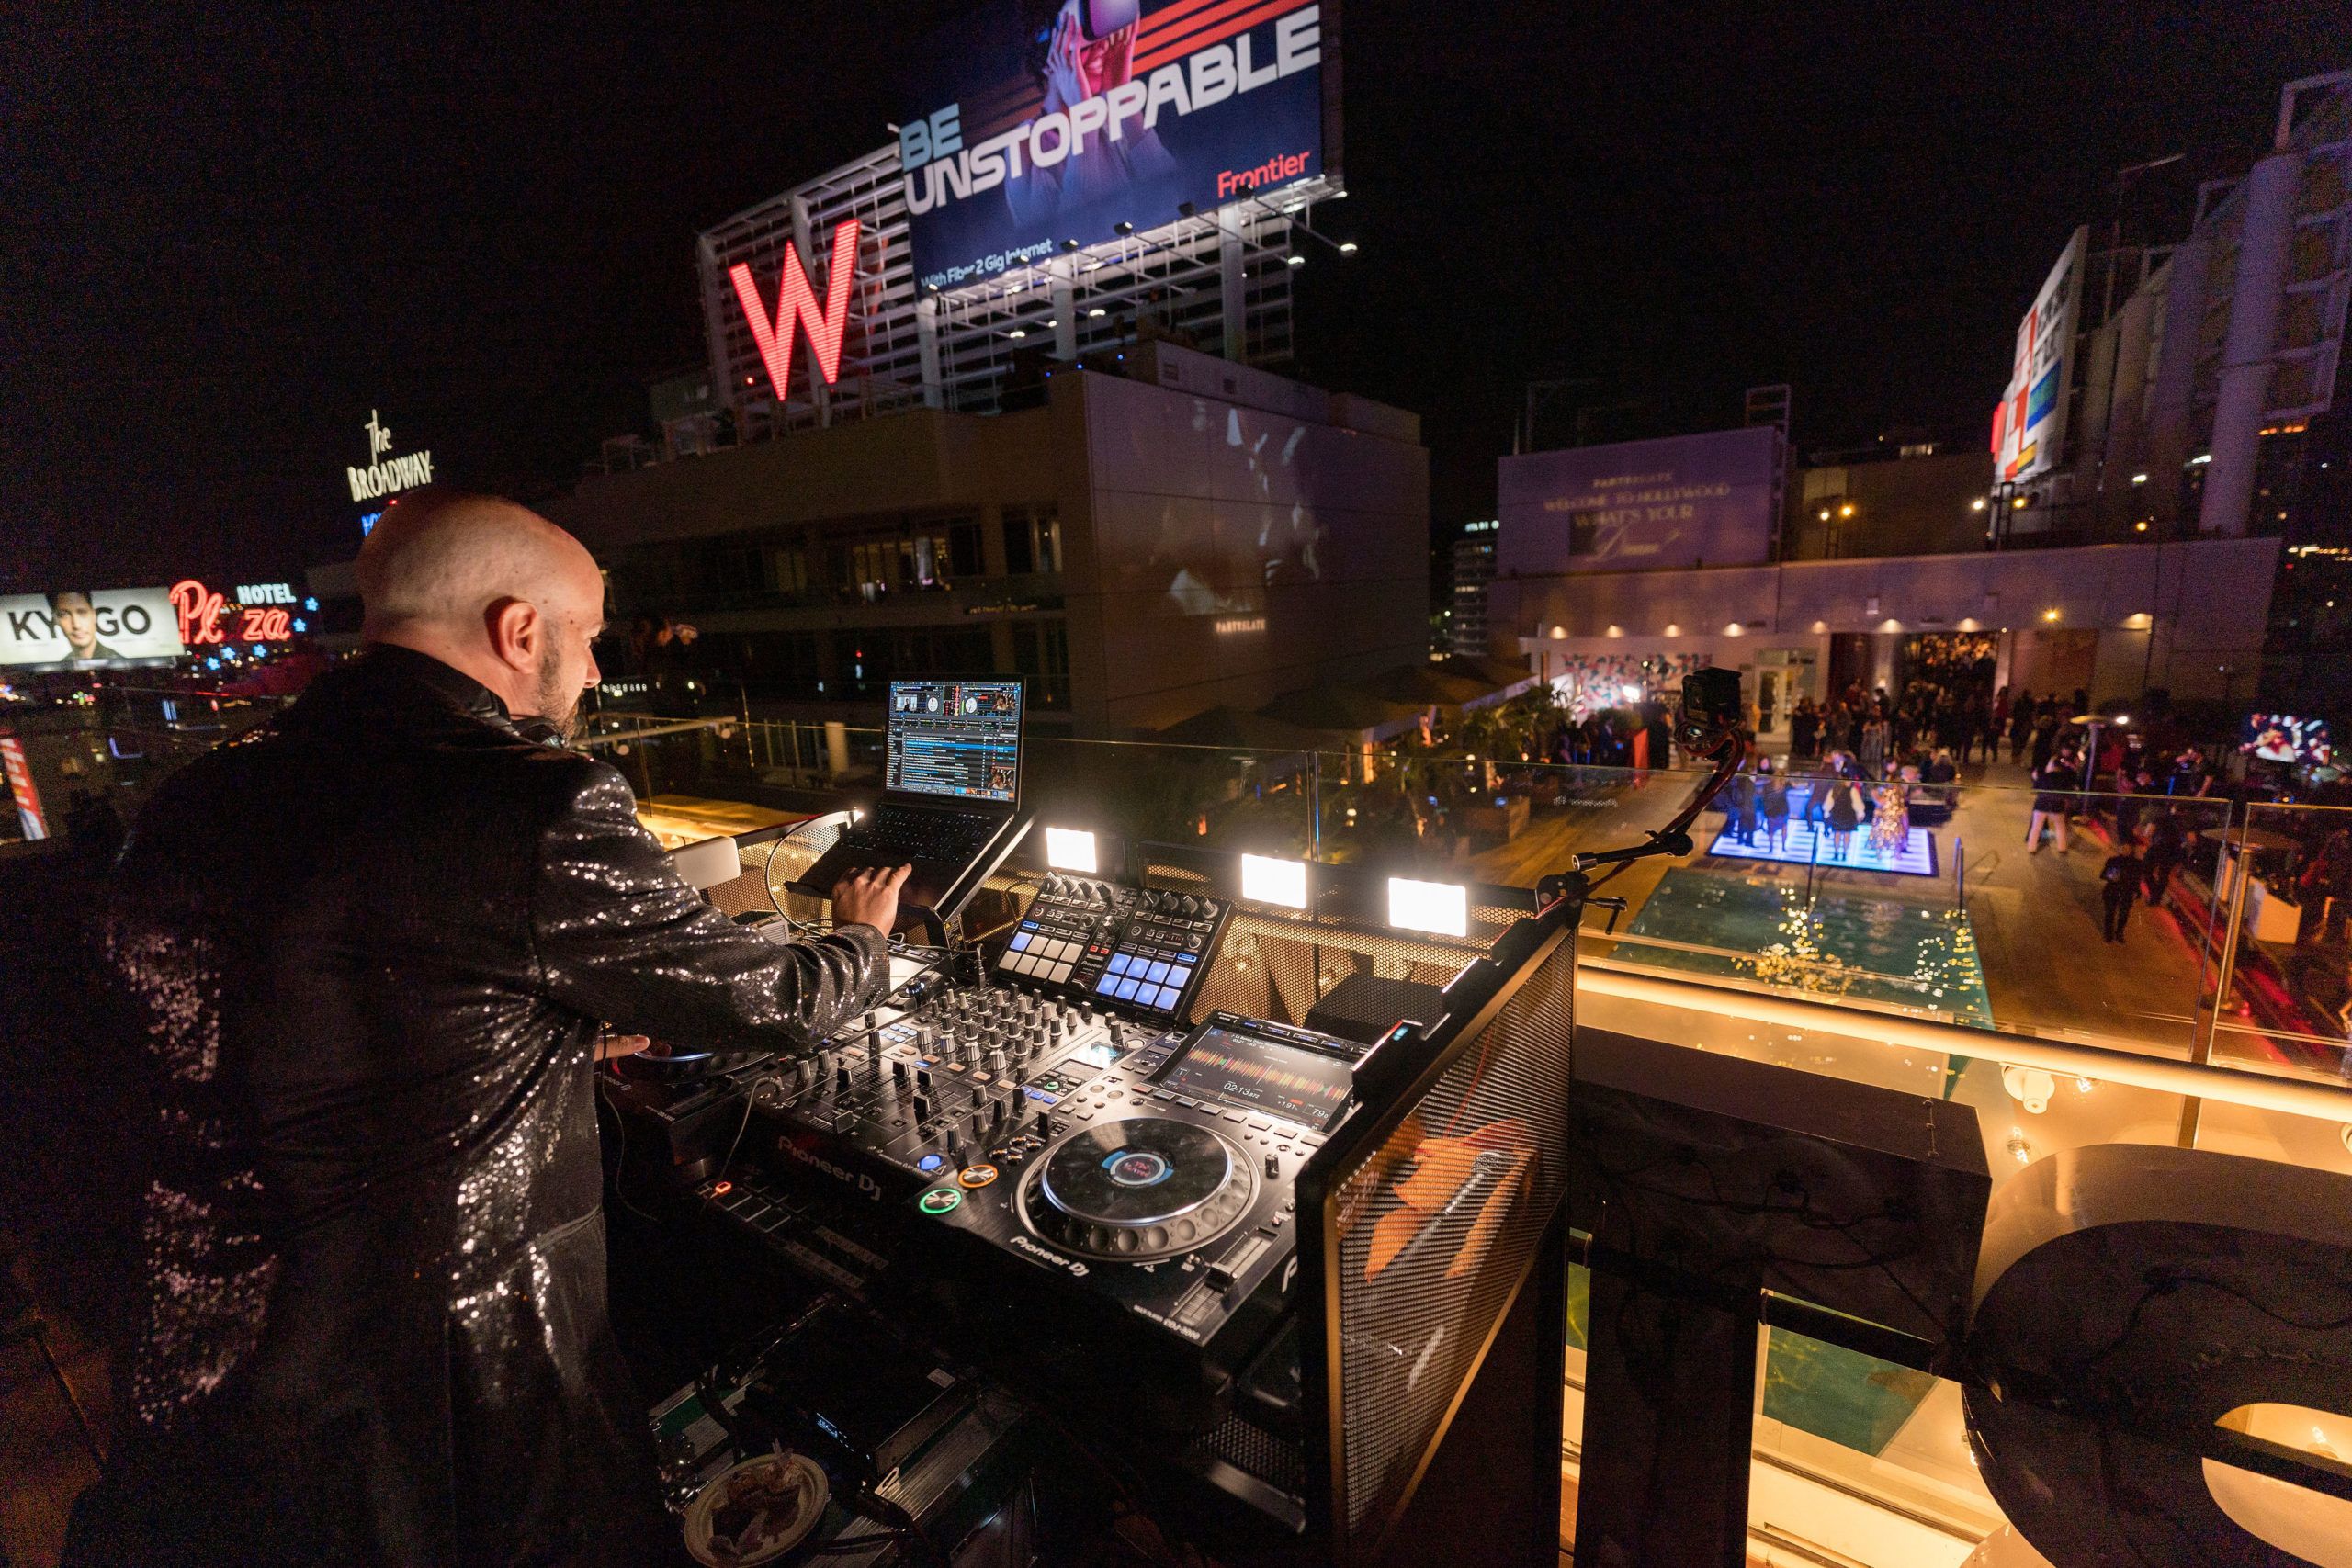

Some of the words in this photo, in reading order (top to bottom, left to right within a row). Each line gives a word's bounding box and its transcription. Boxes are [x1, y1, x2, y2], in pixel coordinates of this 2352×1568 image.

[900, 103, 963, 172] BE
[904, 4, 1321, 215] UNSTOPPABLE
[1217, 151, 1311, 199] Frontier
[975, 258, 985, 276] 2
[985, 254, 1005, 273] Gig
[729, 217, 862, 401] W
[364, 408, 393, 467] The
[346, 449, 433, 502] BROADWAY
[236, 581, 298, 606] HOTEL
[777, 1134, 855, 1183] Pioneer
[858, 1172, 883, 1201] DJ
[1010, 1235, 1070, 1267] Pioneer
[1068, 1260, 1091, 1278] DJ
